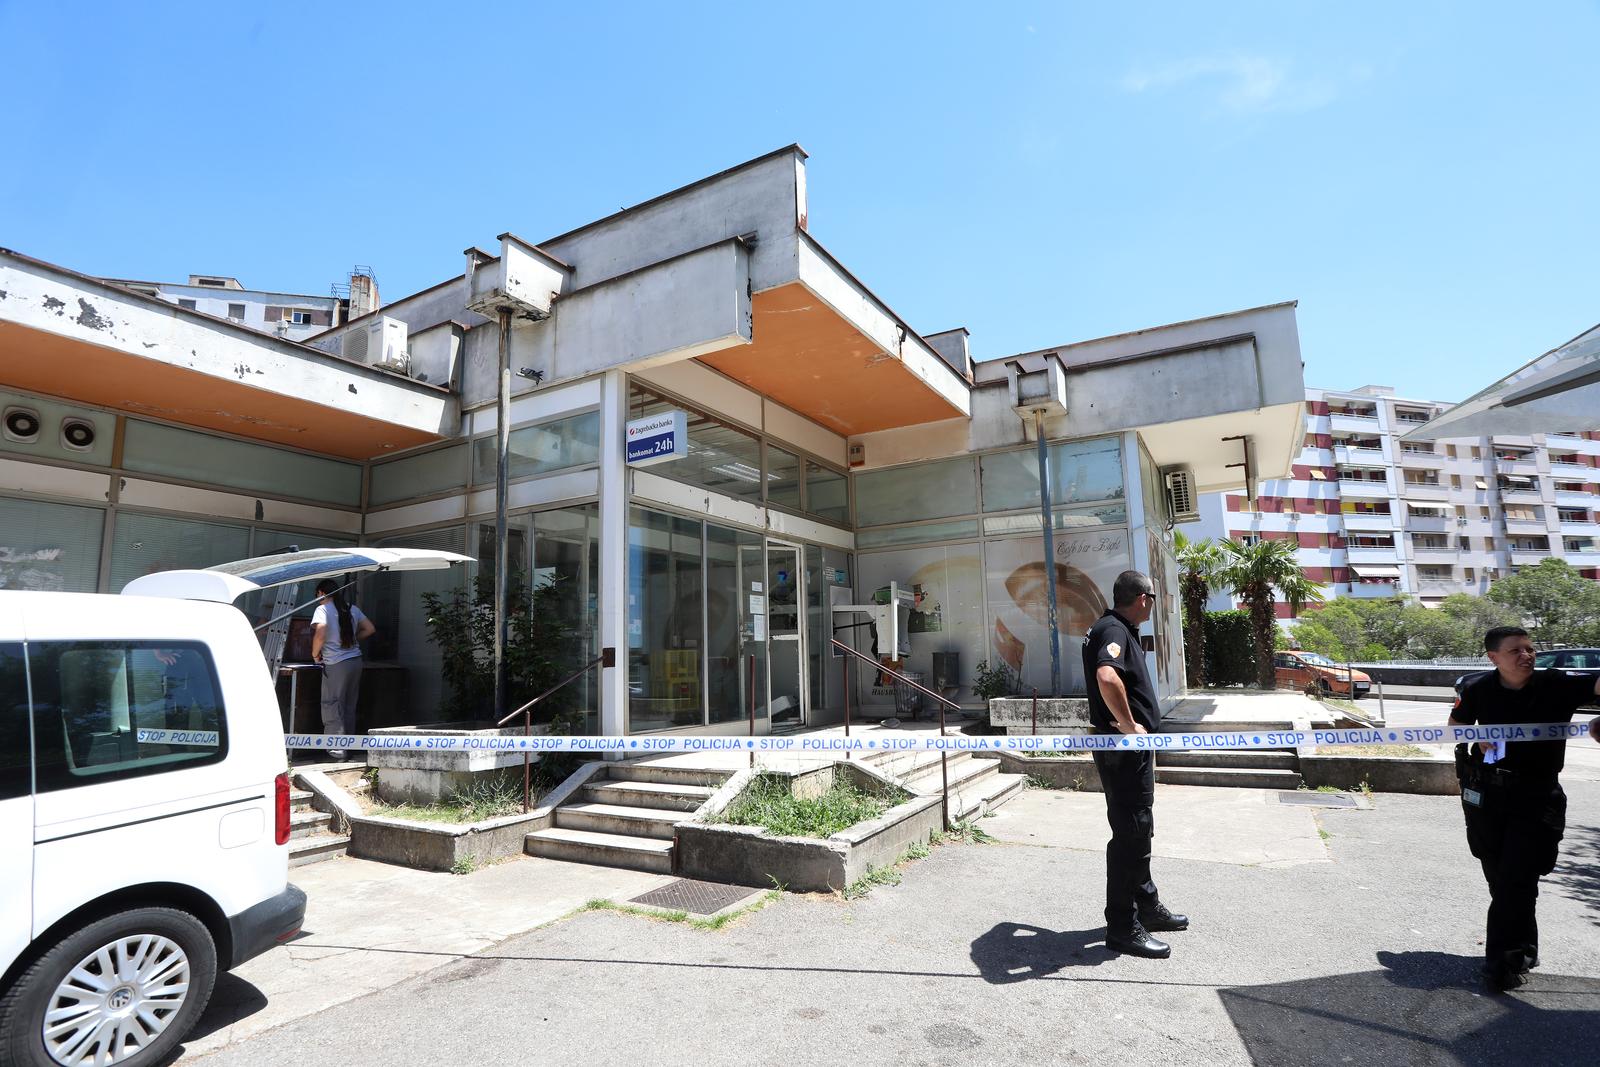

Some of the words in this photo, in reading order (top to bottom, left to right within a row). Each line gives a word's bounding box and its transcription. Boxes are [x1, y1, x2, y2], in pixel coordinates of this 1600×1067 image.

[635, 423, 659, 434] Zagrebačka
[659, 419, 673, 429] banka
[629, 447, 654, 459] bankomat
[655, 438, 673, 453] 24h
[138, 730, 166, 742] STOP
[170, 732, 217, 744] POLICIJA
[285, 735, 312, 747] ICIJA
[326, 736, 355, 747] STOP
[361, 738, 411, 748] POLICIJA
[426, 738, 456, 748] STOP
[463, 738, 515, 749] POLICIJA
[531, 738, 563, 749] STOP
[570, 738, 625, 749] POLICIJA
[642, 738, 676, 749] STOP
[683, 738, 741, 749] POLICIJA
[760, 738, 794, 749] STOP
[802, 738, 863, 749] POLICIJA
[882, 738, 917, 749] STOP
[926, 738, 988, 749] POLICIJA
[1008, 737, 1044, 749] STOP
[1053, 737, 1117, 749] POLICIJA
[1135, 736, 1172, 748] STOP
[1182, 734, 1248, 748] POLICIJA
[1267, 732, 1304, 745] STOP
[1315, 730, 1383, 744] POLICIJA
[1403, 729, 1444, 742] STOP
[1454, 726, 1526, 741] POLICIJA
[1548, 724, 1589, 737] STOP
